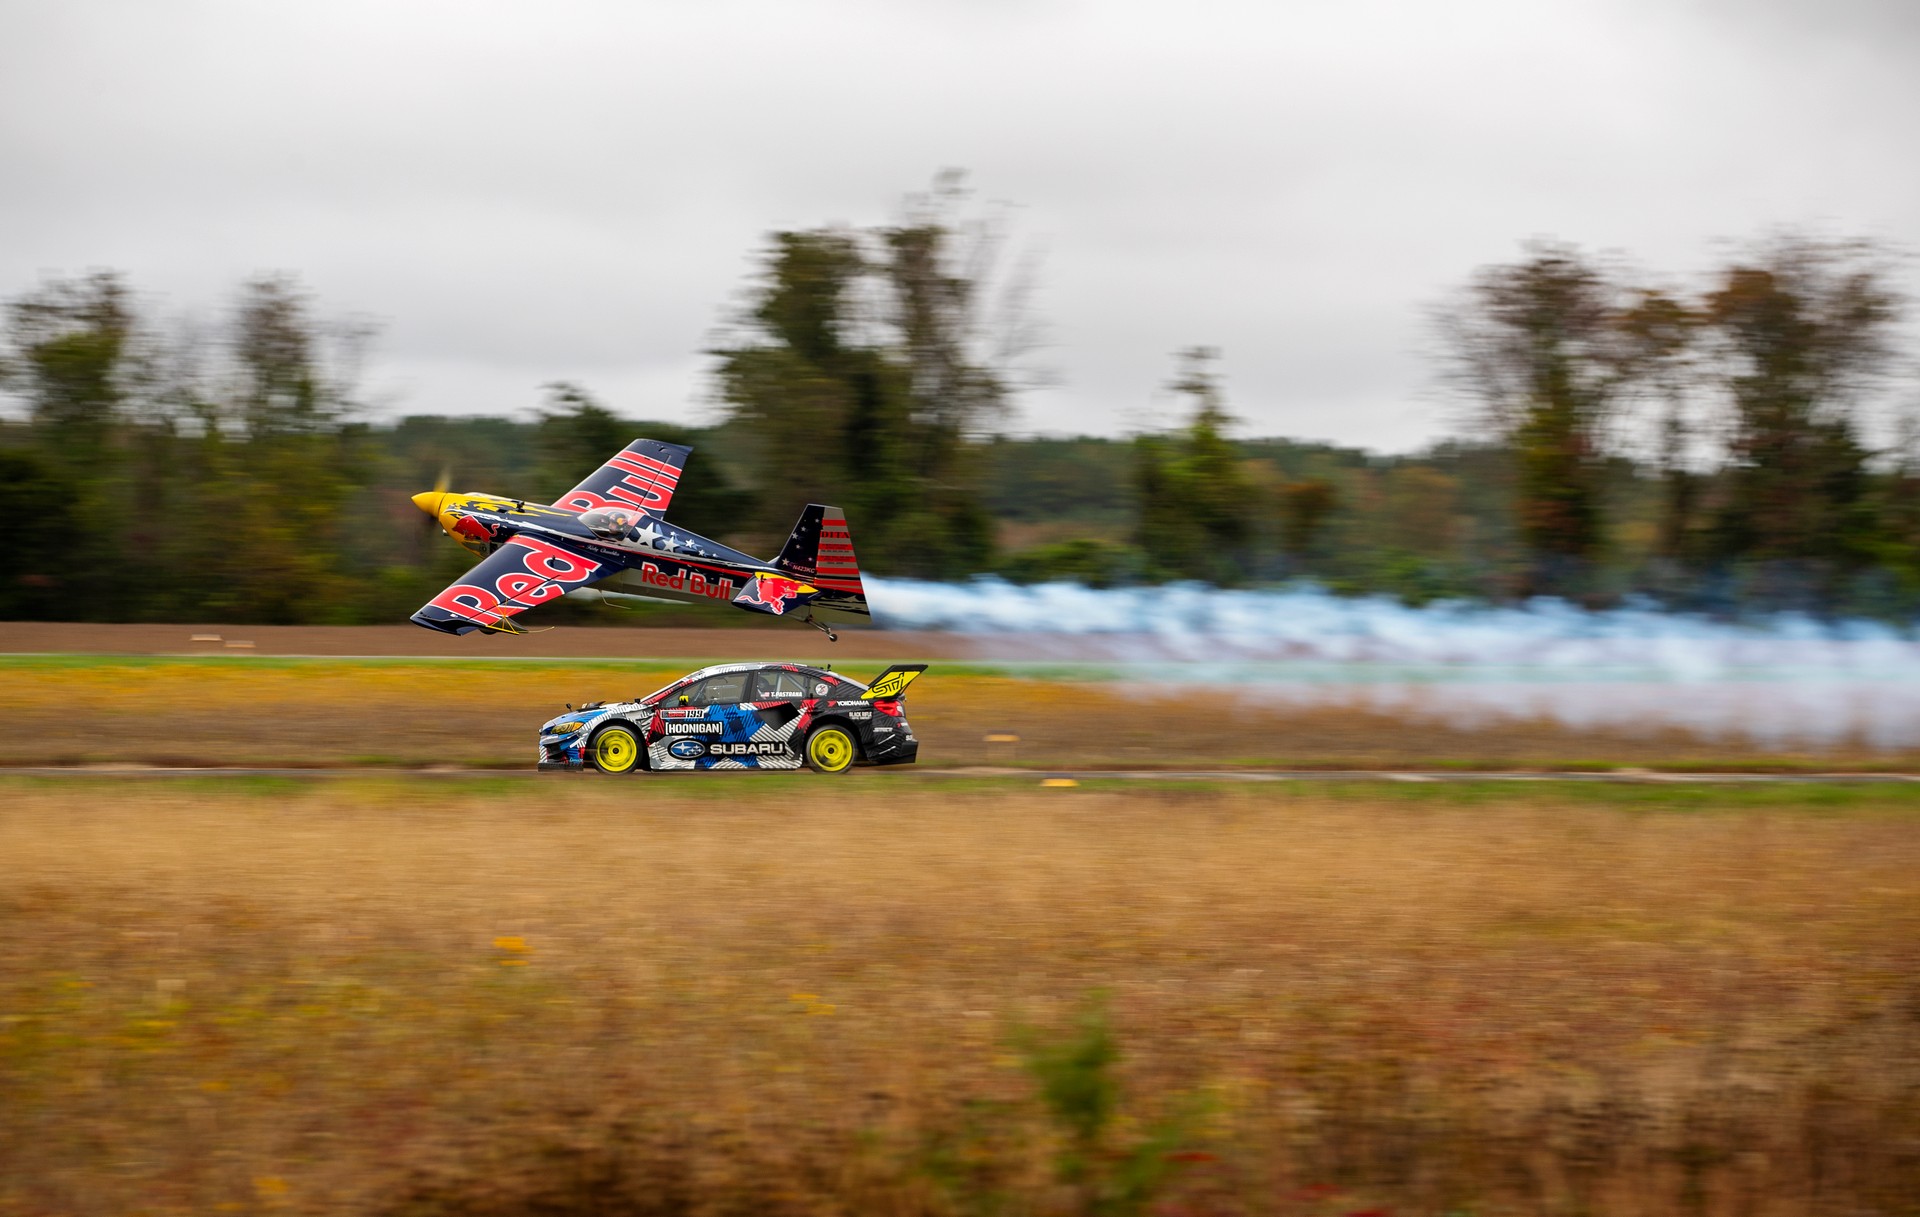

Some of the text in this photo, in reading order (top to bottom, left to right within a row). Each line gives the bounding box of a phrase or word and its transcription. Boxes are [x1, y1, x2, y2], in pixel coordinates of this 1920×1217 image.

[550, 450, 682, 516] Bull
[428, 534, 602, 627] Red
[641, 561, 733, 600] Red Bull
[687, 710, 704, 718] 199
[710, 743, 784, 755] SUBARU
